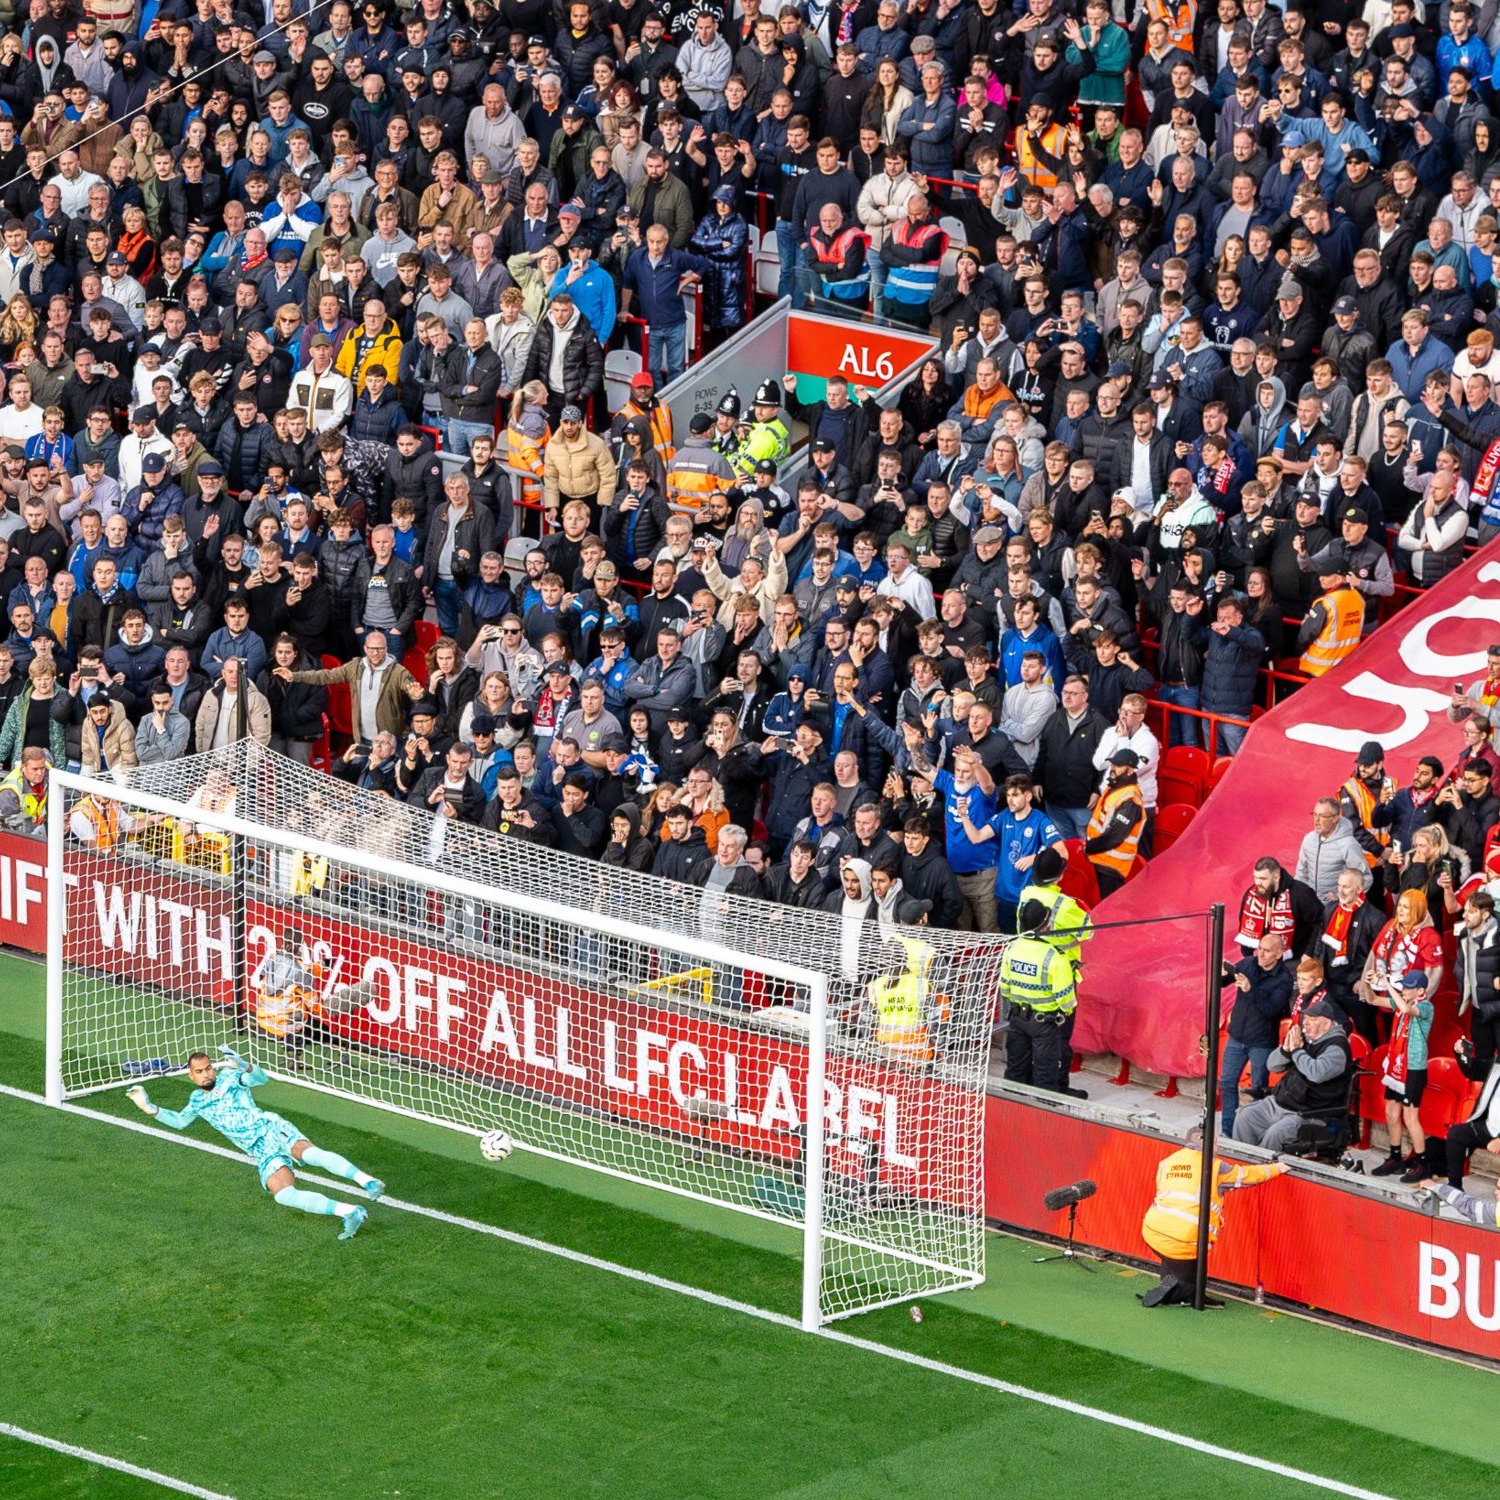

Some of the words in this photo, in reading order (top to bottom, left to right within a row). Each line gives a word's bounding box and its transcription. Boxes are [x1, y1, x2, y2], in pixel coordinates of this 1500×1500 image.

[838, 344, 894, 381] AL6
[694, 386, 718, 400] ROWS
[694, 401, 713, 413] 8-35
[1011, 960, 1037, 976] POLICE
[92, 879, 233, 983] WITH
[363, 955, 468, 1042] OFF
[479, 989, 588, 1081] ALL
[603, 1018, 708, 1110] LFC
[1170, 1164, 1192, 1172] CROWD
[1165, 1172, 1193, 1180] STEWARD
